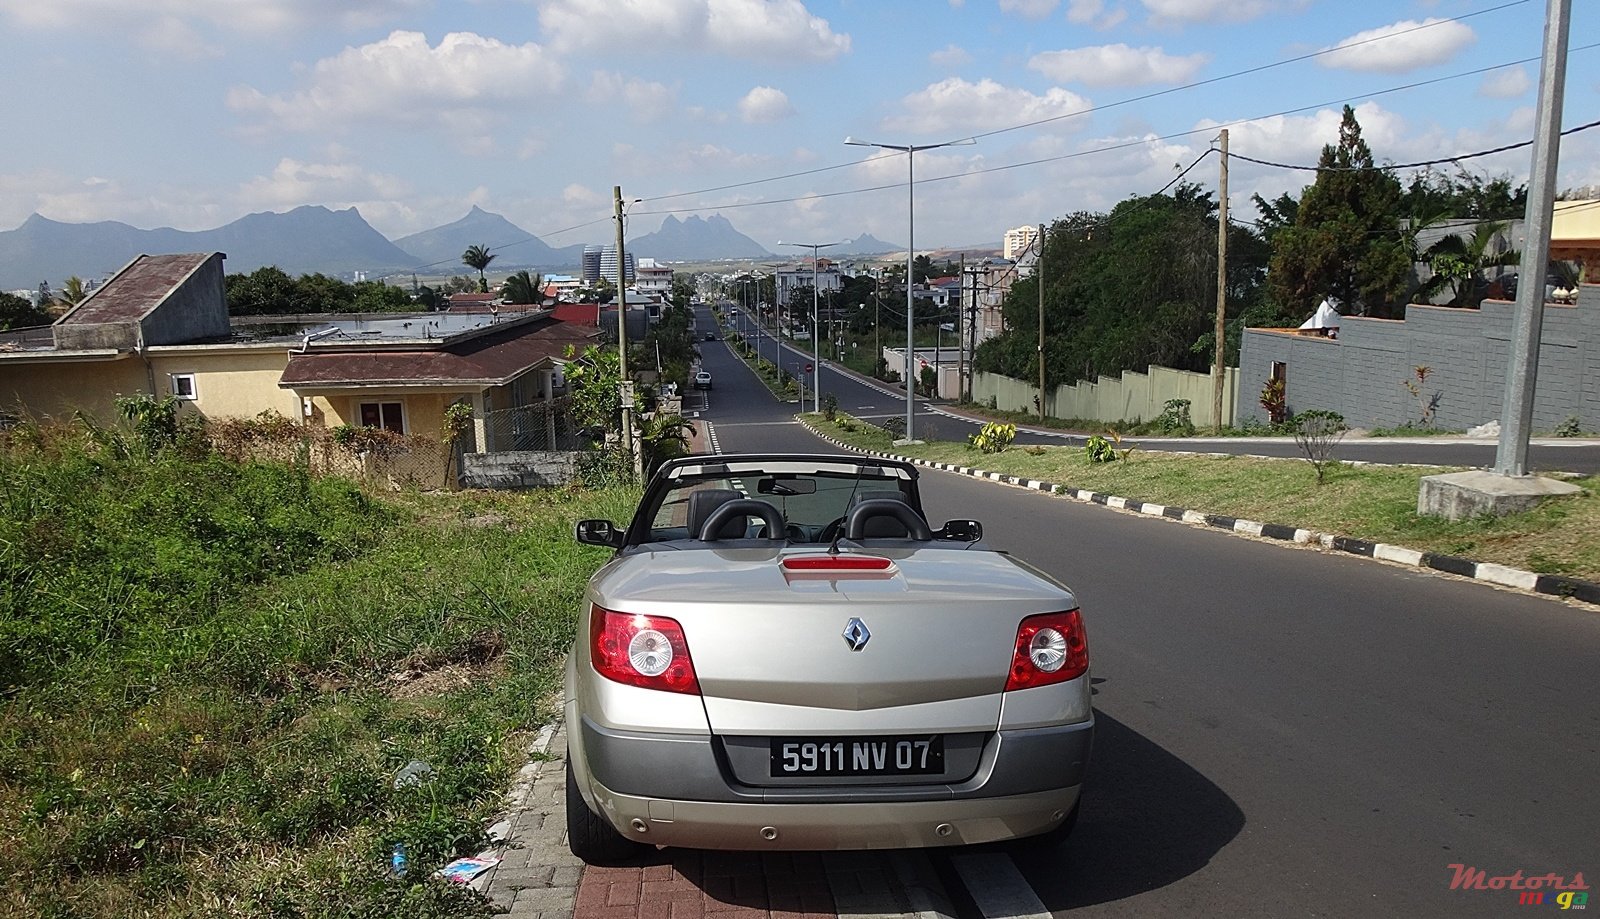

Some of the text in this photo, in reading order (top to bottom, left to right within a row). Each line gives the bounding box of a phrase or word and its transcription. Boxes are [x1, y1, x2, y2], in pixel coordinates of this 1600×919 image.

[783, 741, 930, 771] 5911 NV 07
